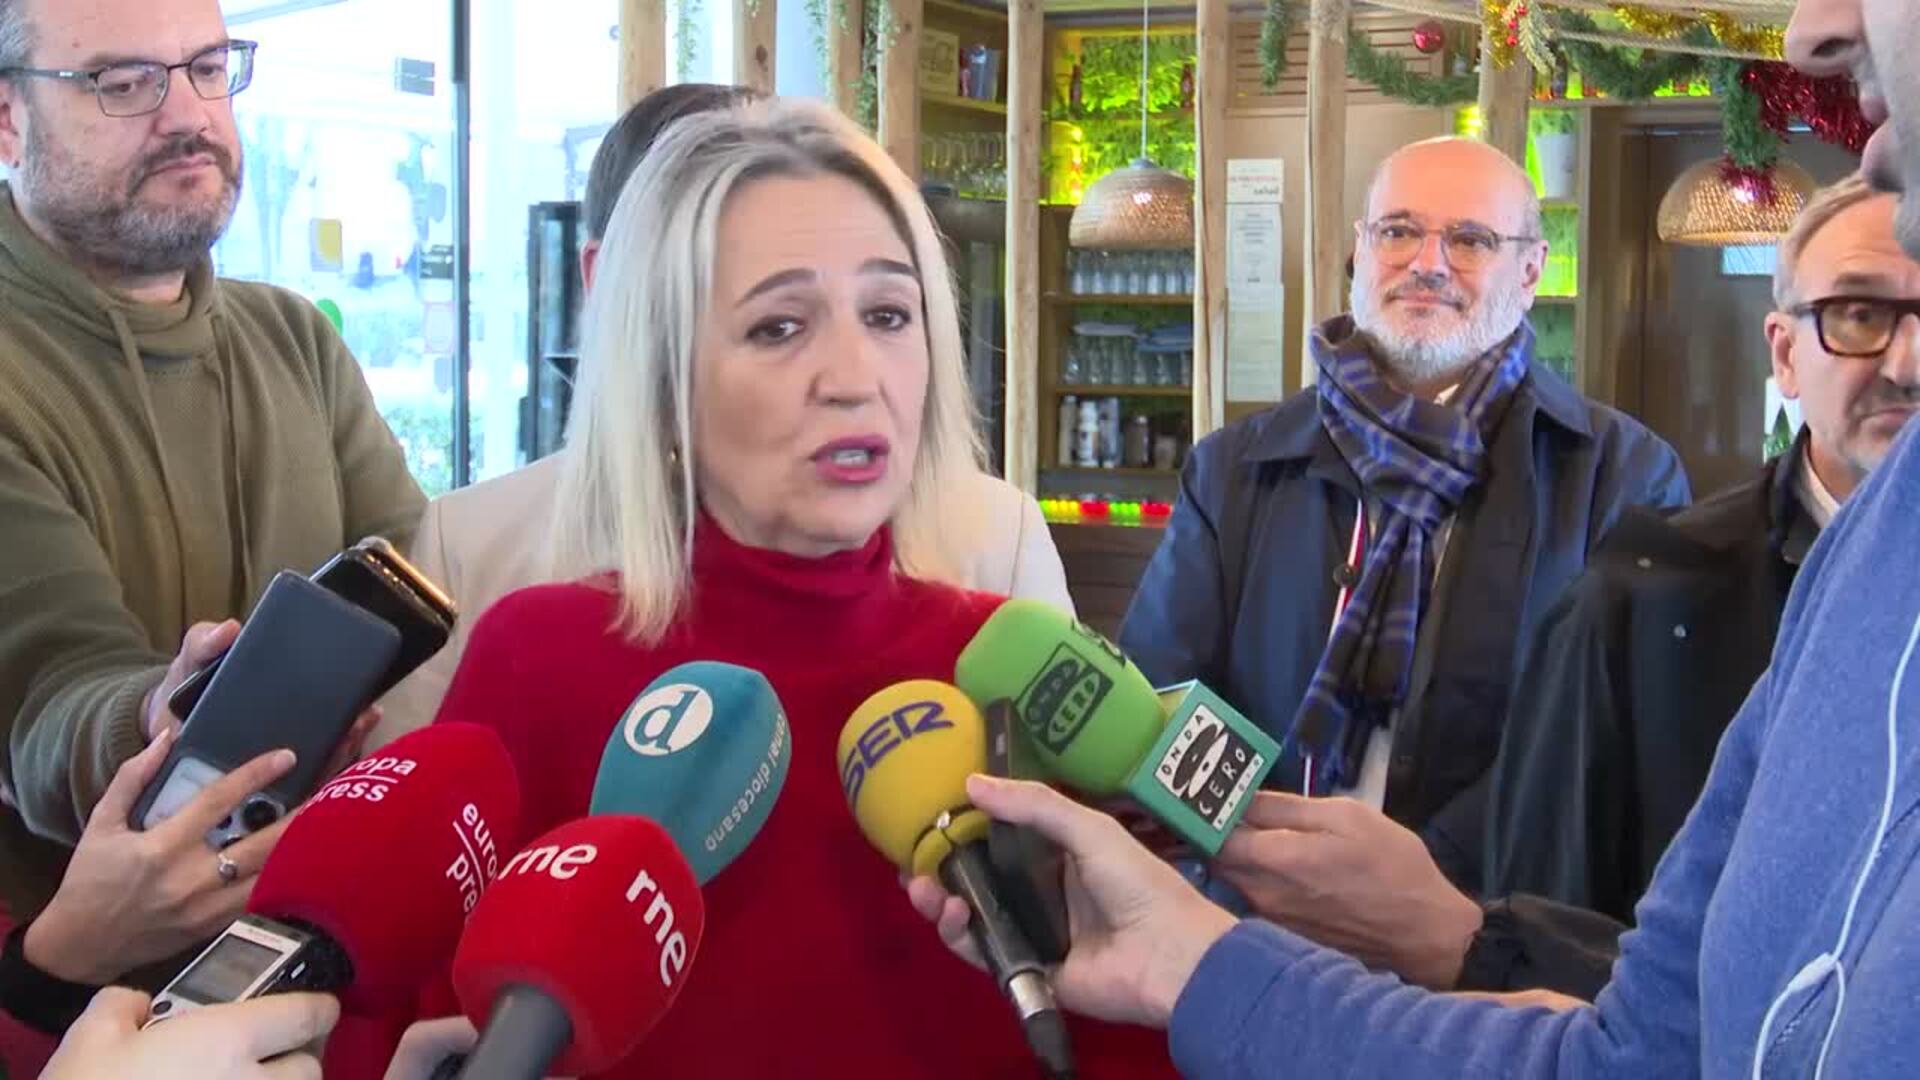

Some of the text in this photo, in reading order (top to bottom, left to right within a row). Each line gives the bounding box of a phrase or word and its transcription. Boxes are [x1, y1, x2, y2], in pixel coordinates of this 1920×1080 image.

[1052, 678, 1096, 734] CERO
[843, 700, 955, 814] SER
[1161, 714, 1204, 776] ONDA
[704, 762, 772, 851] diocesano
[1199, 747, 1246, 815] CERO
[462, 803, 498, 879] euro
[498, 843, 598, 880] rne
[445, 853, 478, 913] pre
[625, 868, 687, 987] rne
